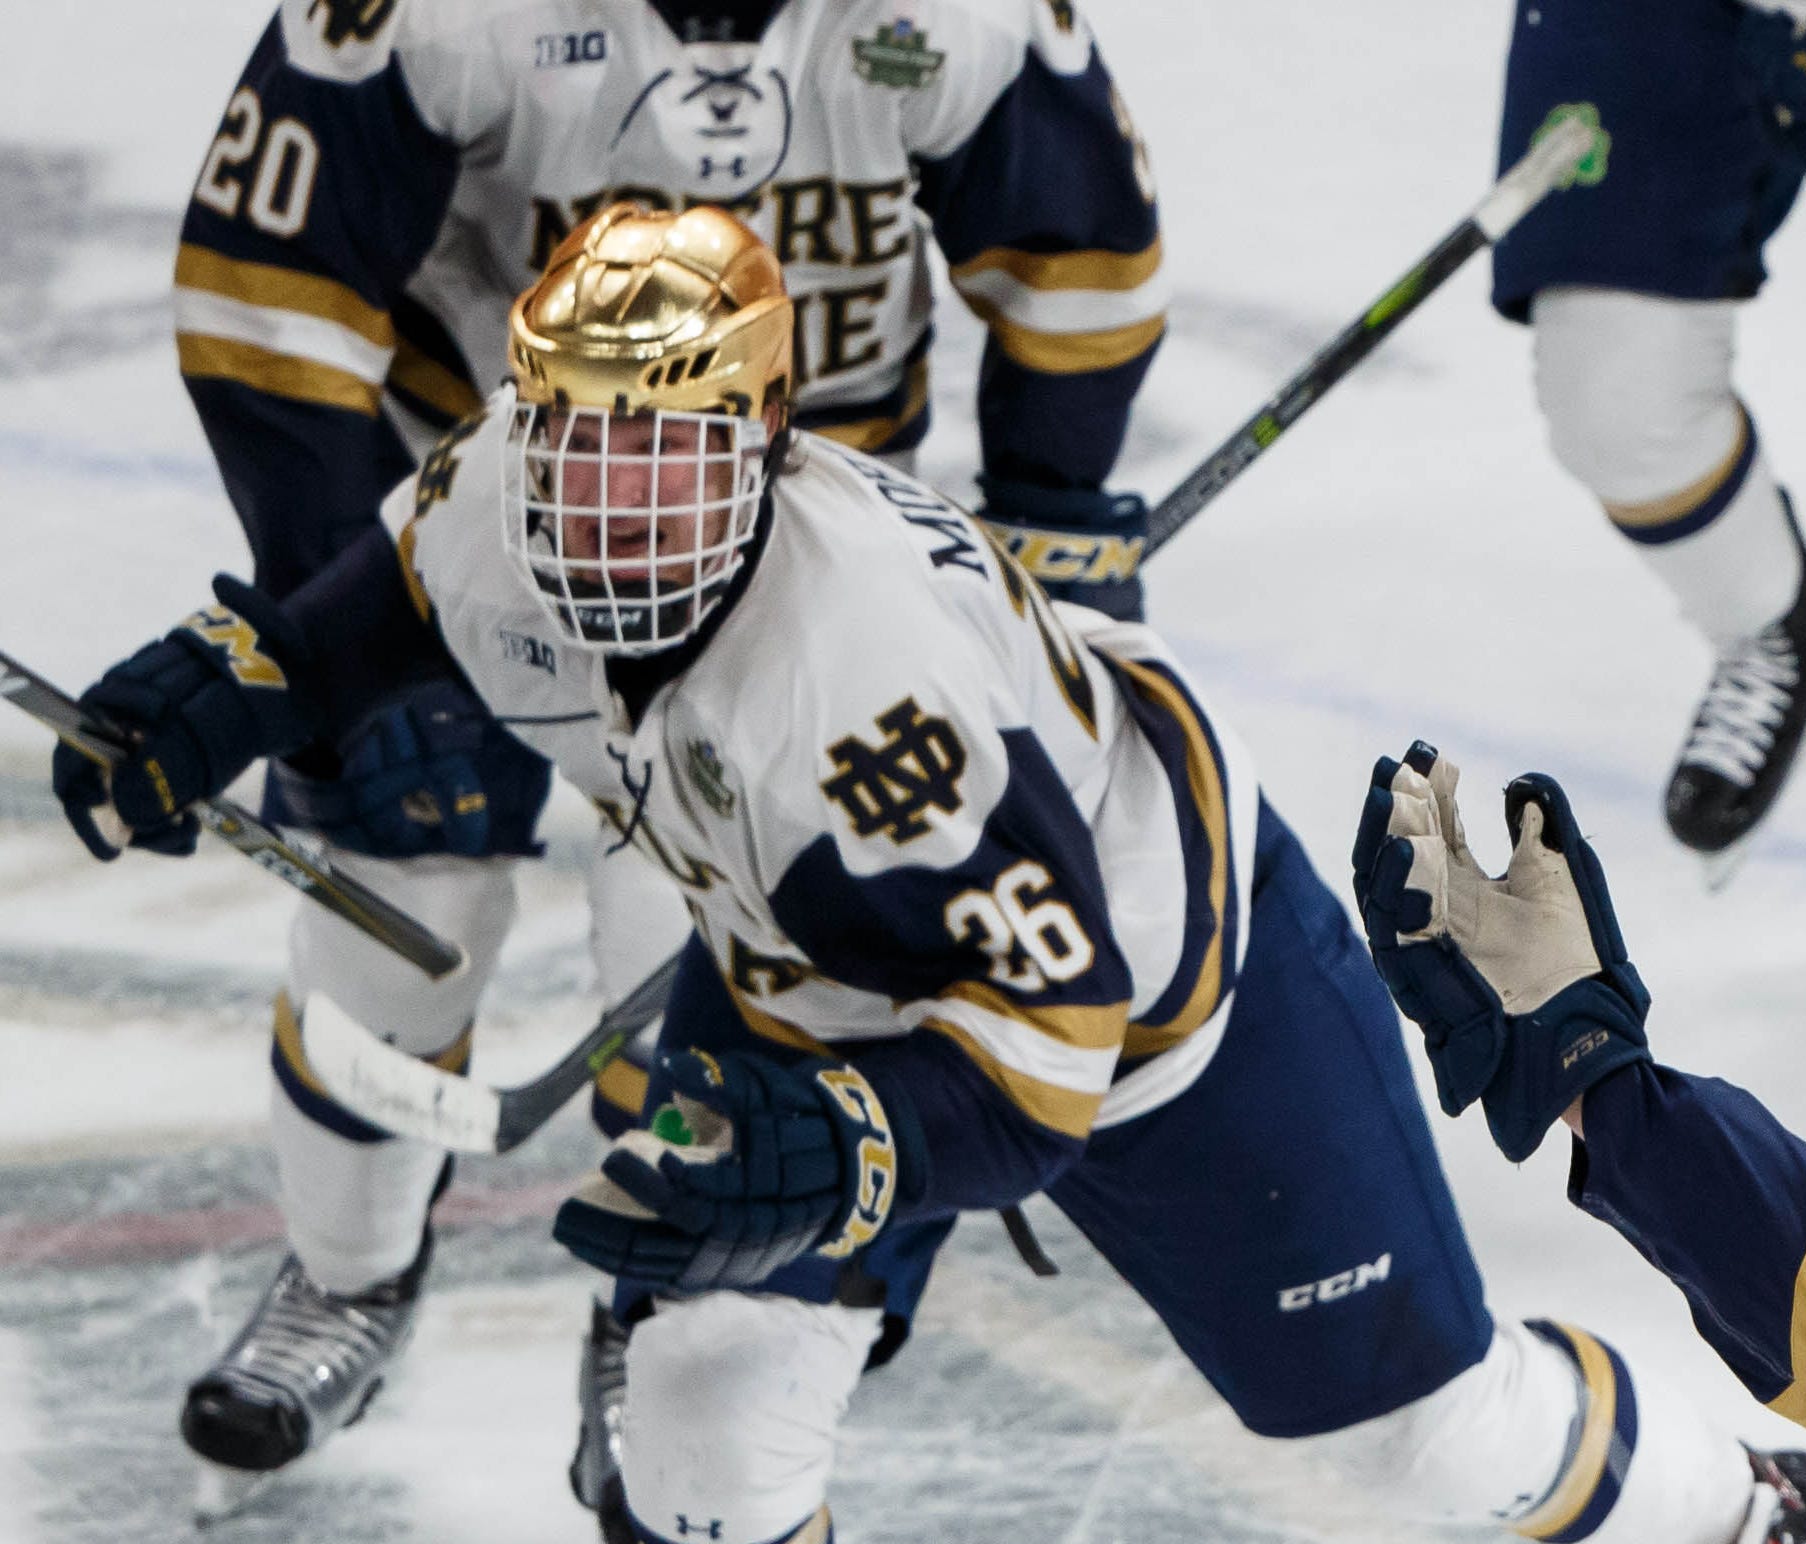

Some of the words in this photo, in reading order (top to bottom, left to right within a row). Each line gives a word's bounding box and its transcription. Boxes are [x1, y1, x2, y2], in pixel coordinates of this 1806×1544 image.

[195, 86, 320, 239] 20
[528, 176, 910, 271] NRE
[1277, 1251, 1392, 1313] CCM
